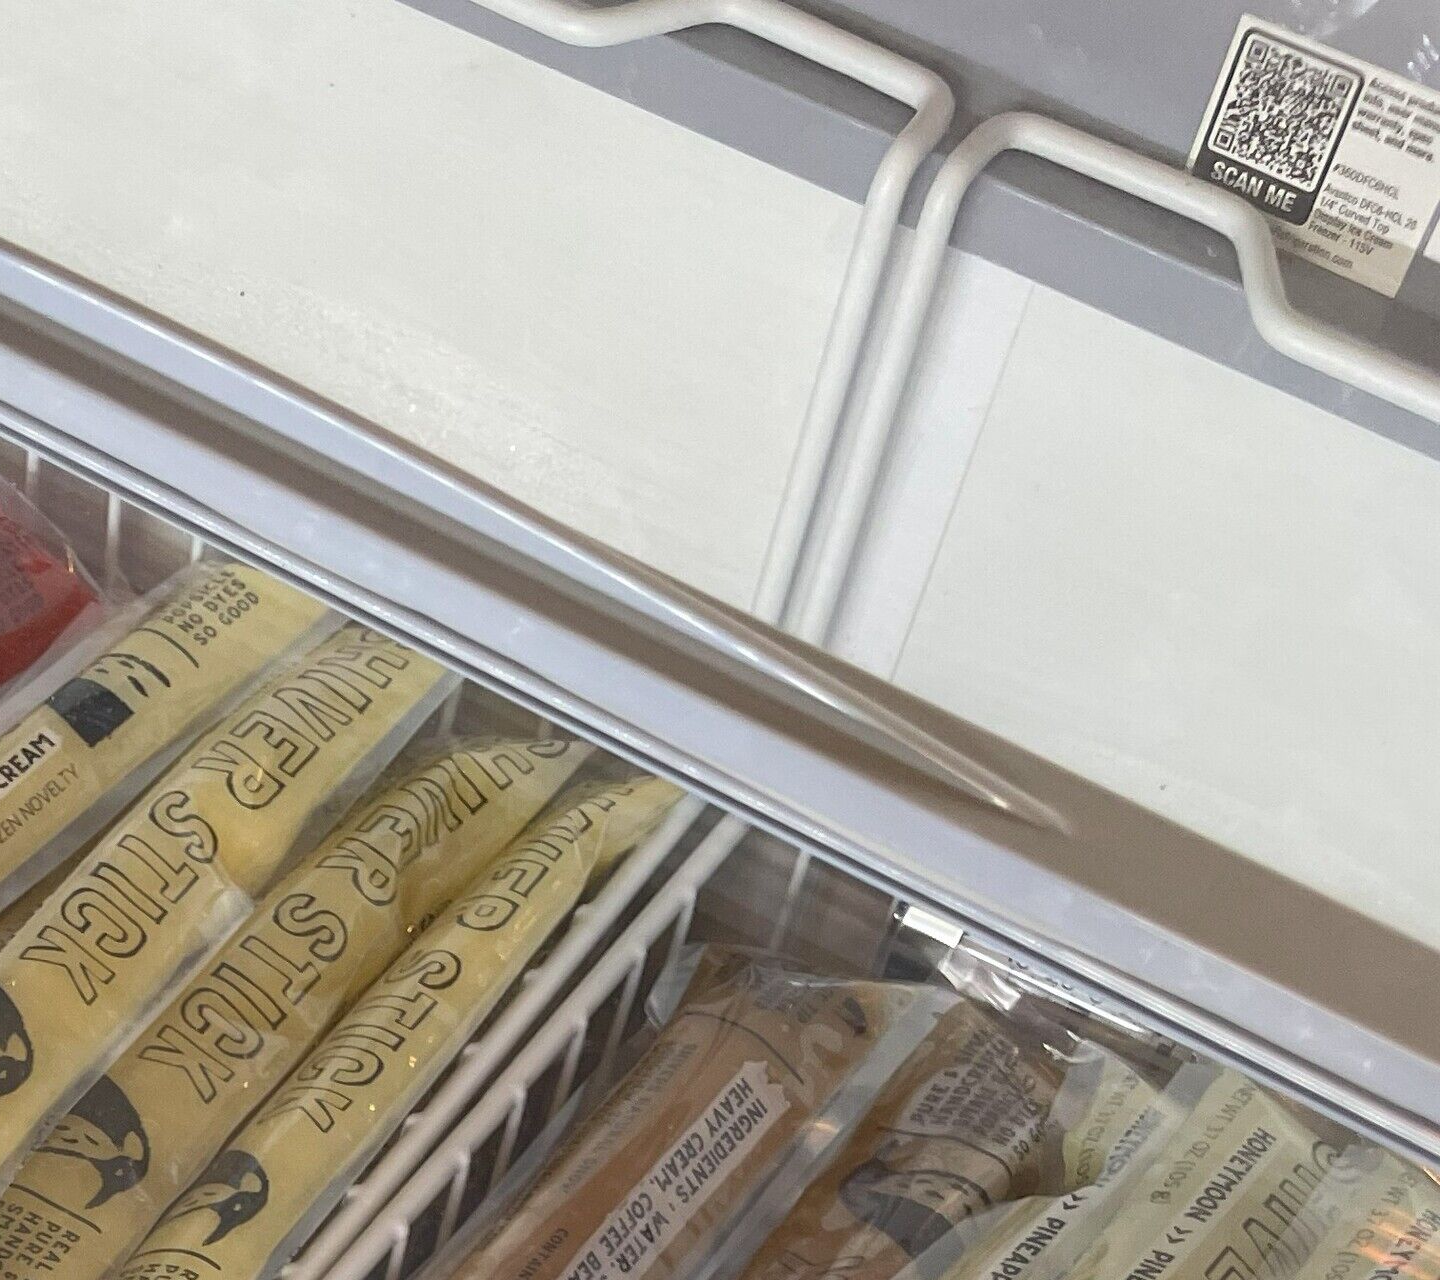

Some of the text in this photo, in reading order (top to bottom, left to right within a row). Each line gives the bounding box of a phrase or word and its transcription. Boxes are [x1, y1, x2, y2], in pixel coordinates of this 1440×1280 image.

[1208, 160, 1298, 213] SCAN ME
[1371, 219, 1391, 236] Top
[193, 589, 261, 646] SO GOOD
[135, 882, 361, 1112] STICK
[699, 1076, 755, 1136] HEAVY
[1182, 1125, 1278, 1226] HONEYMOON
[33, 1226, 77, 1276] REAL
[597, 1192, 657, 1256] COFFEE
